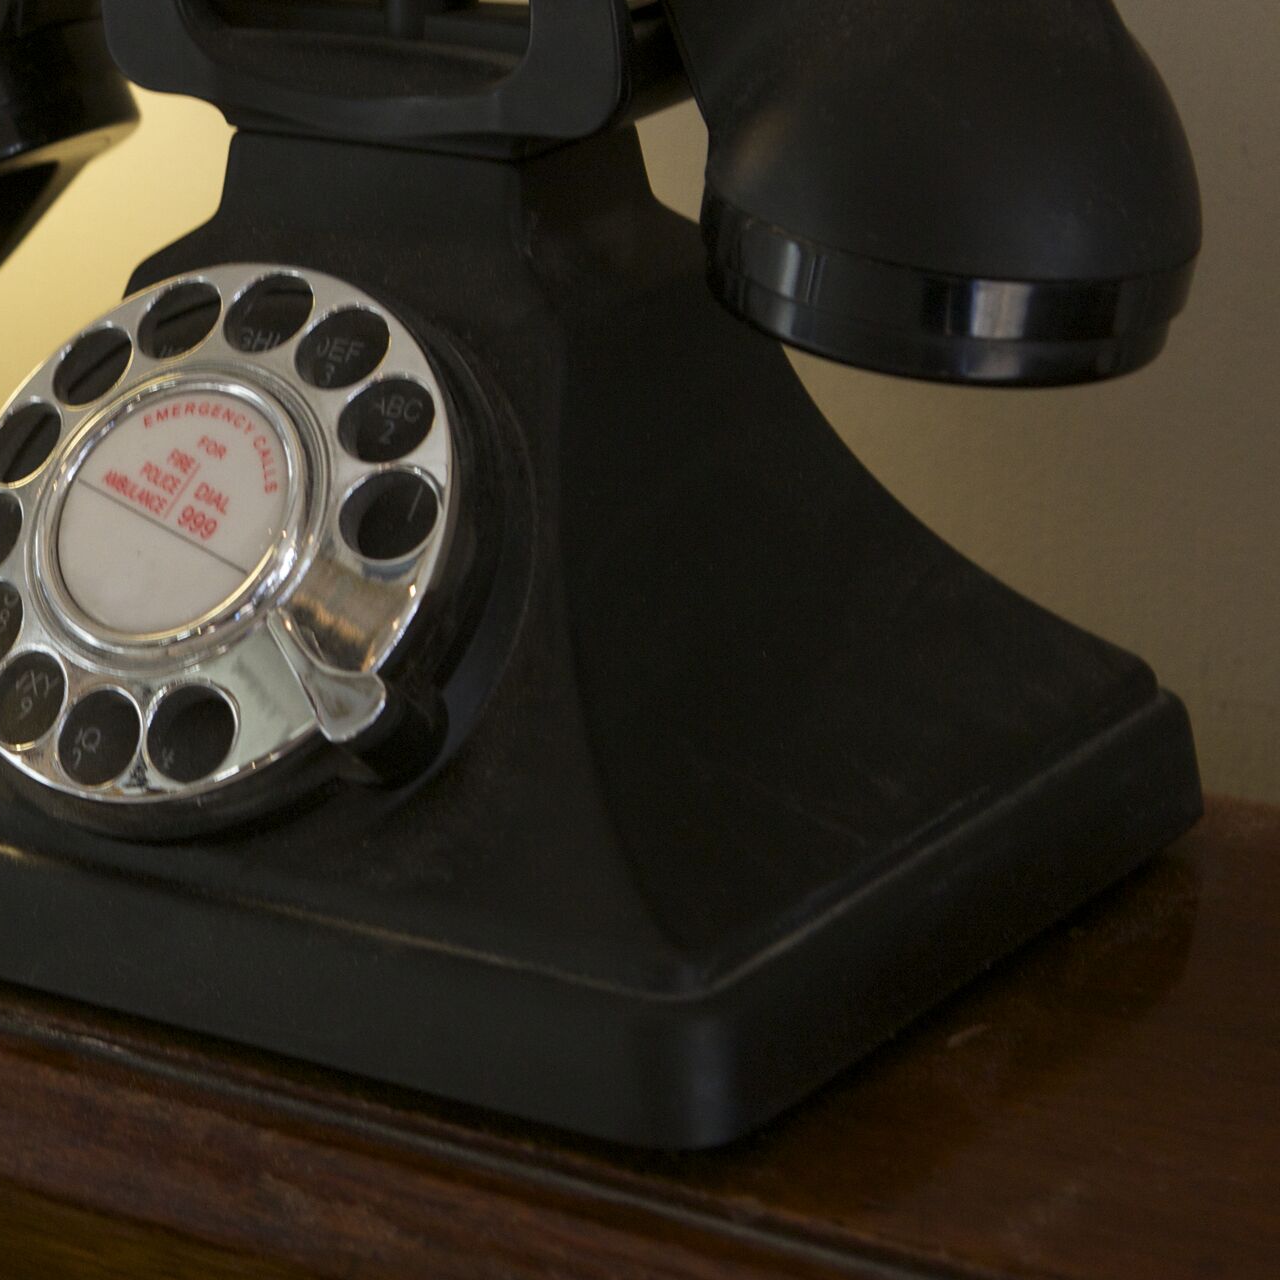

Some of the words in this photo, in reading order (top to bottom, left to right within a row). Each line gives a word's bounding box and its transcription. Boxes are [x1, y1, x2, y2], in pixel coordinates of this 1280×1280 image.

[143, 401, 256, 434] EMERGENCY
[252, 436, 279, 495] CALLS
[166, 447, 197, 476] FIRE
[196, 434, 228, 460] FOR
[101, 468, 168, 516] AMBULANCE
[139, 460, 182, 496] POLICE
[192, 481, 231, 516] DIAL
[176, 504, 219, 541] 999
